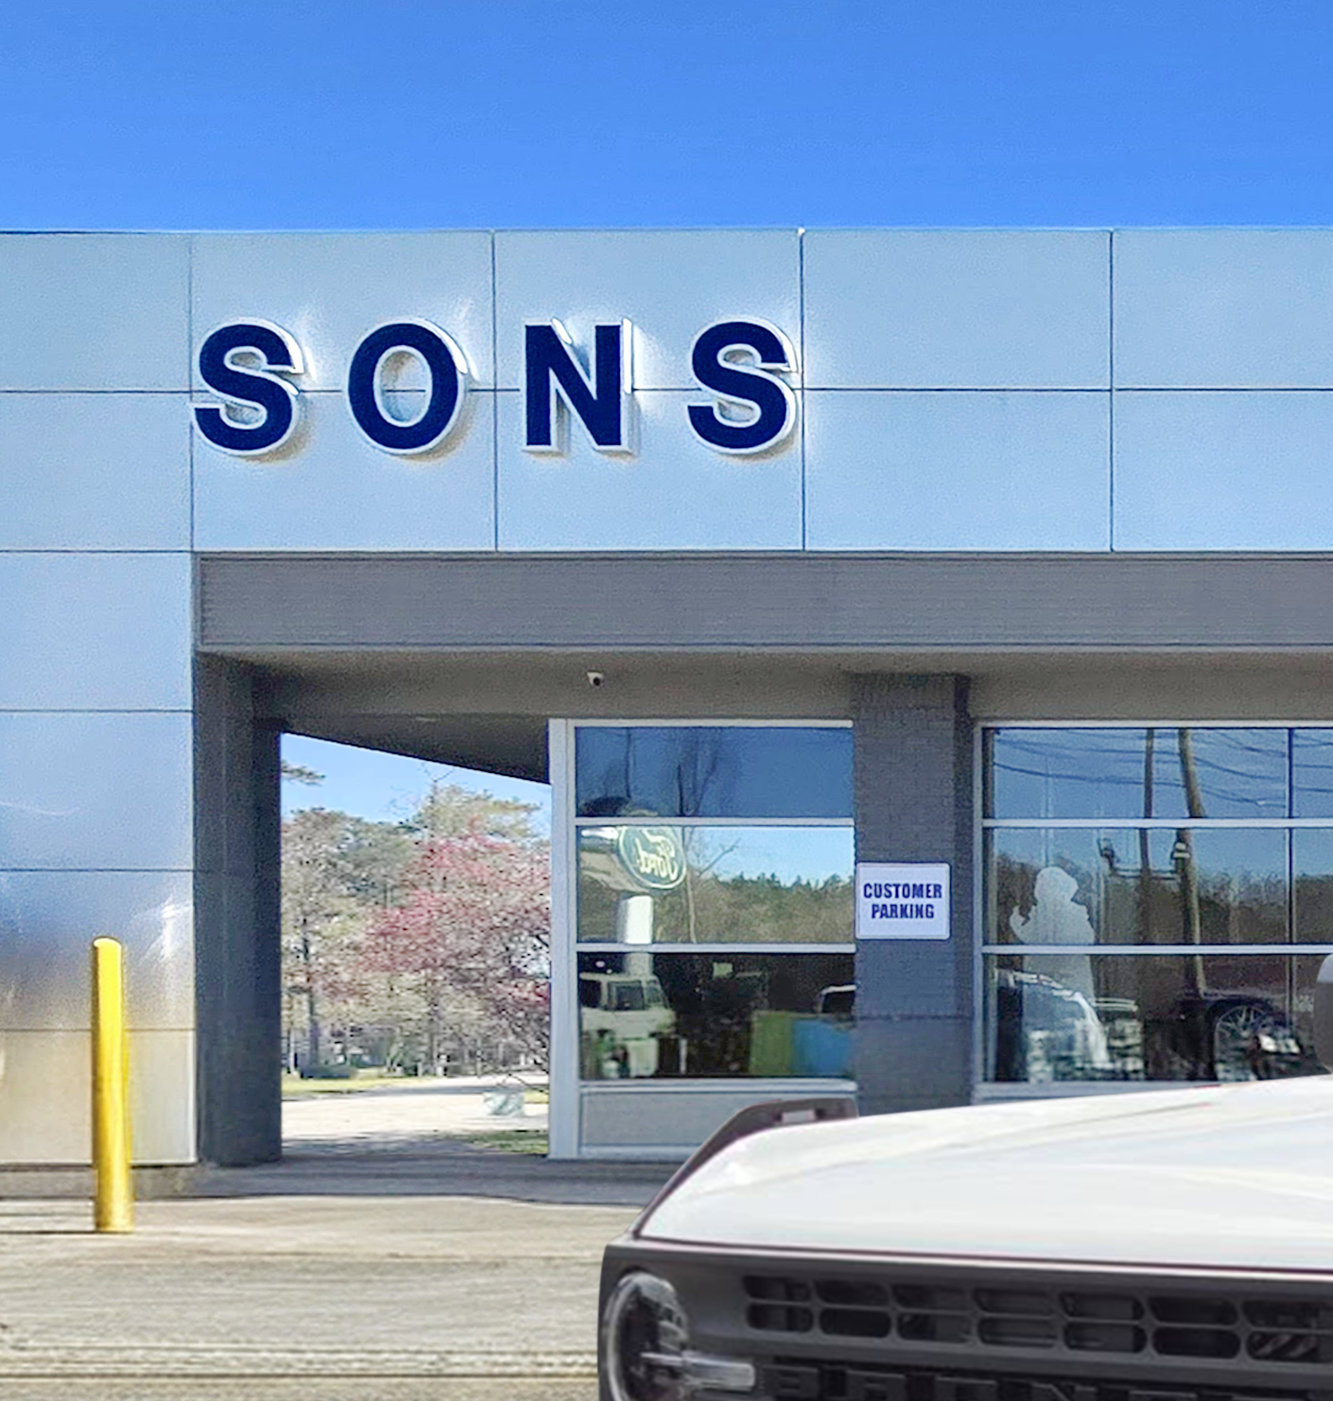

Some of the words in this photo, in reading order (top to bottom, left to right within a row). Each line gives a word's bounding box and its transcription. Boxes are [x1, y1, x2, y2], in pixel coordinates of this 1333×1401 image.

[193, 319, 797, 456] SONS
[863, 882, 942, 899] CUSTOMER
[871, 903, 934, 919] PARKING
